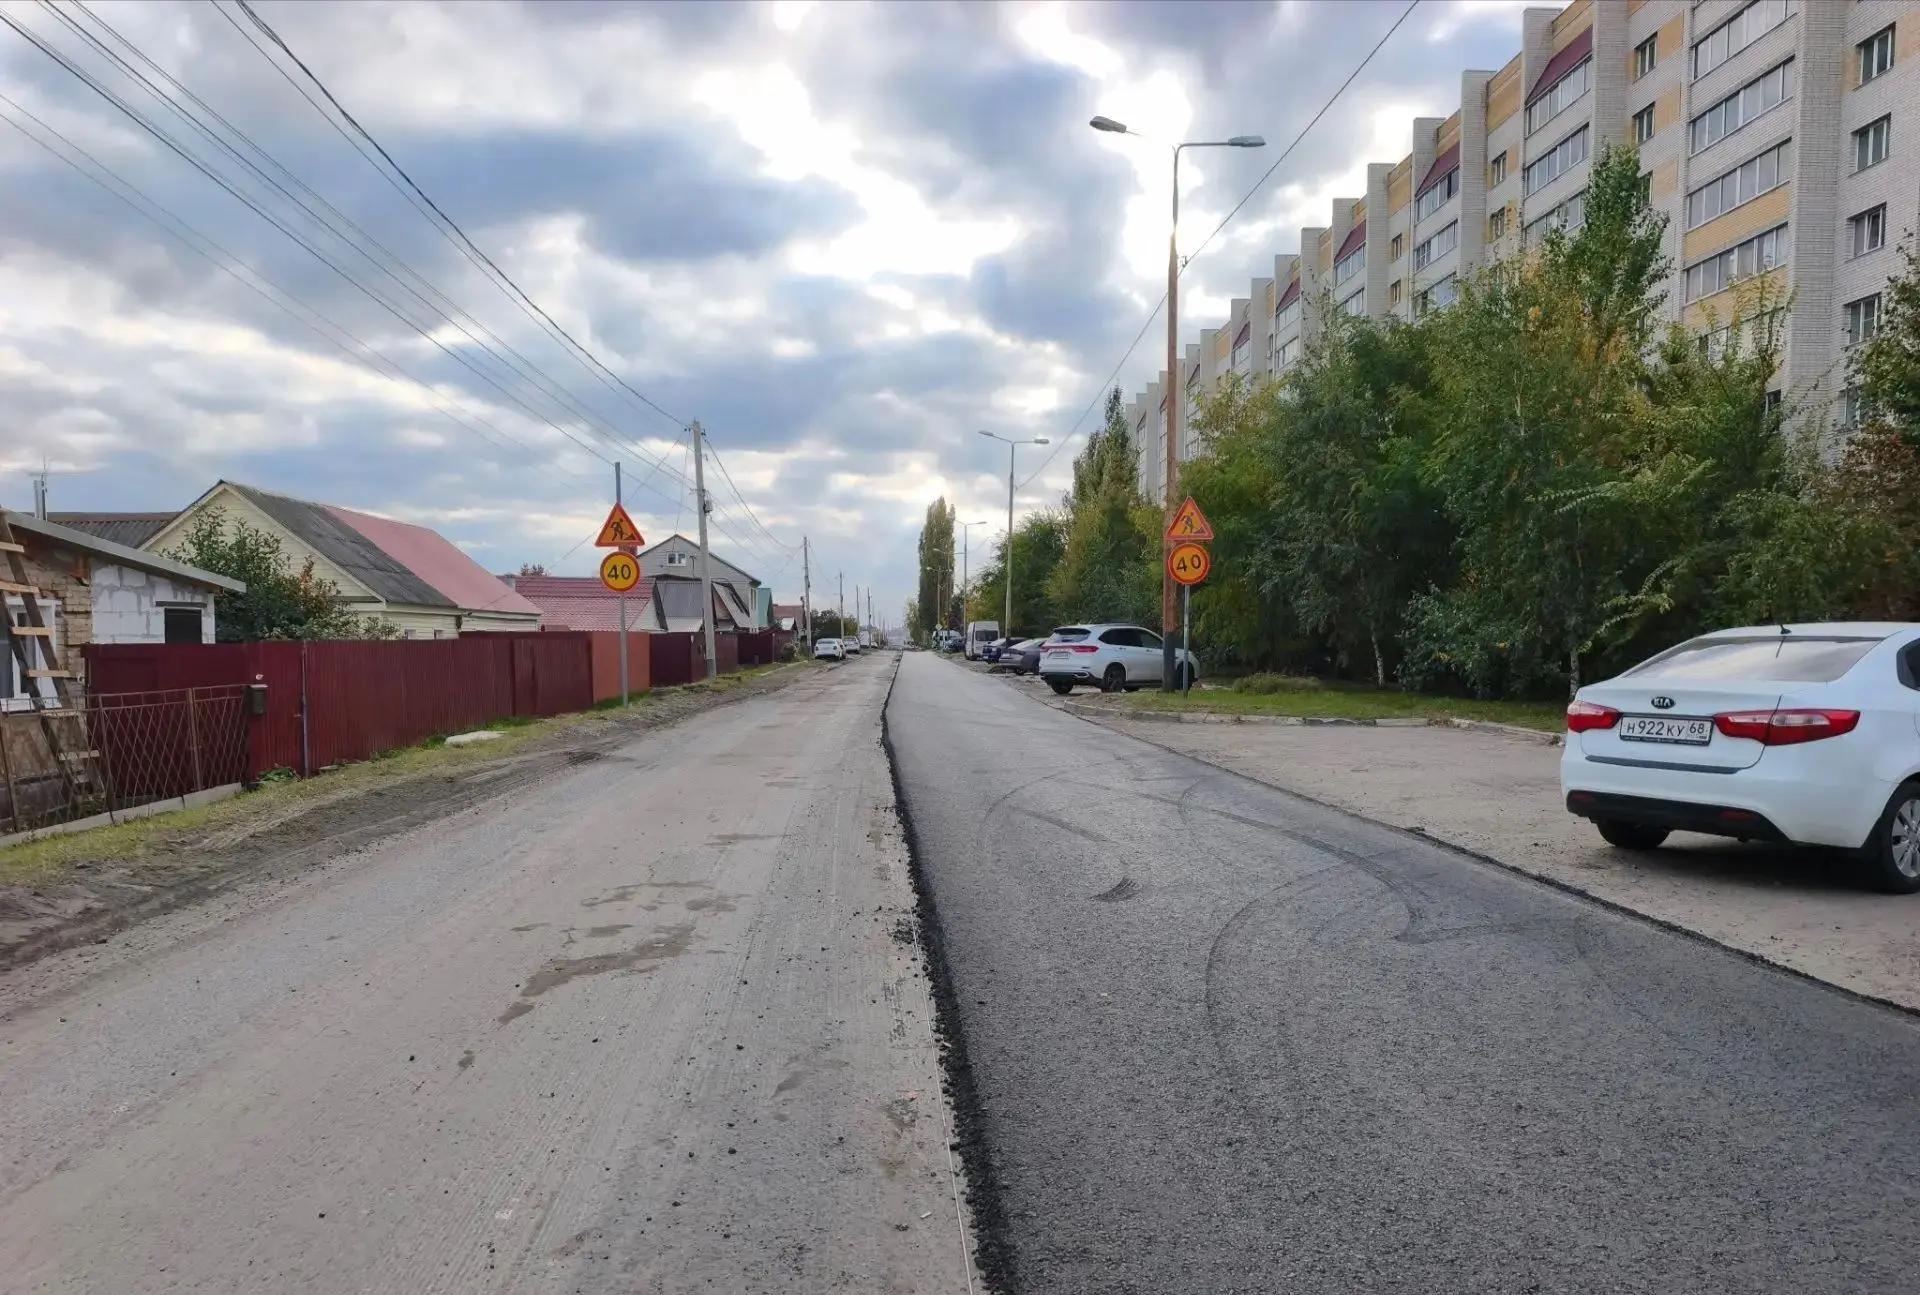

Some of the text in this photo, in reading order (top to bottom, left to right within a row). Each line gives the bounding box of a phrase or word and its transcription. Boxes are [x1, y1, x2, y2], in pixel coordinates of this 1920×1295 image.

[1176, 554, 1201, 572] 40
[607, 564, 631, 580] 40
[1653, 698, 1672, 707] KIA
